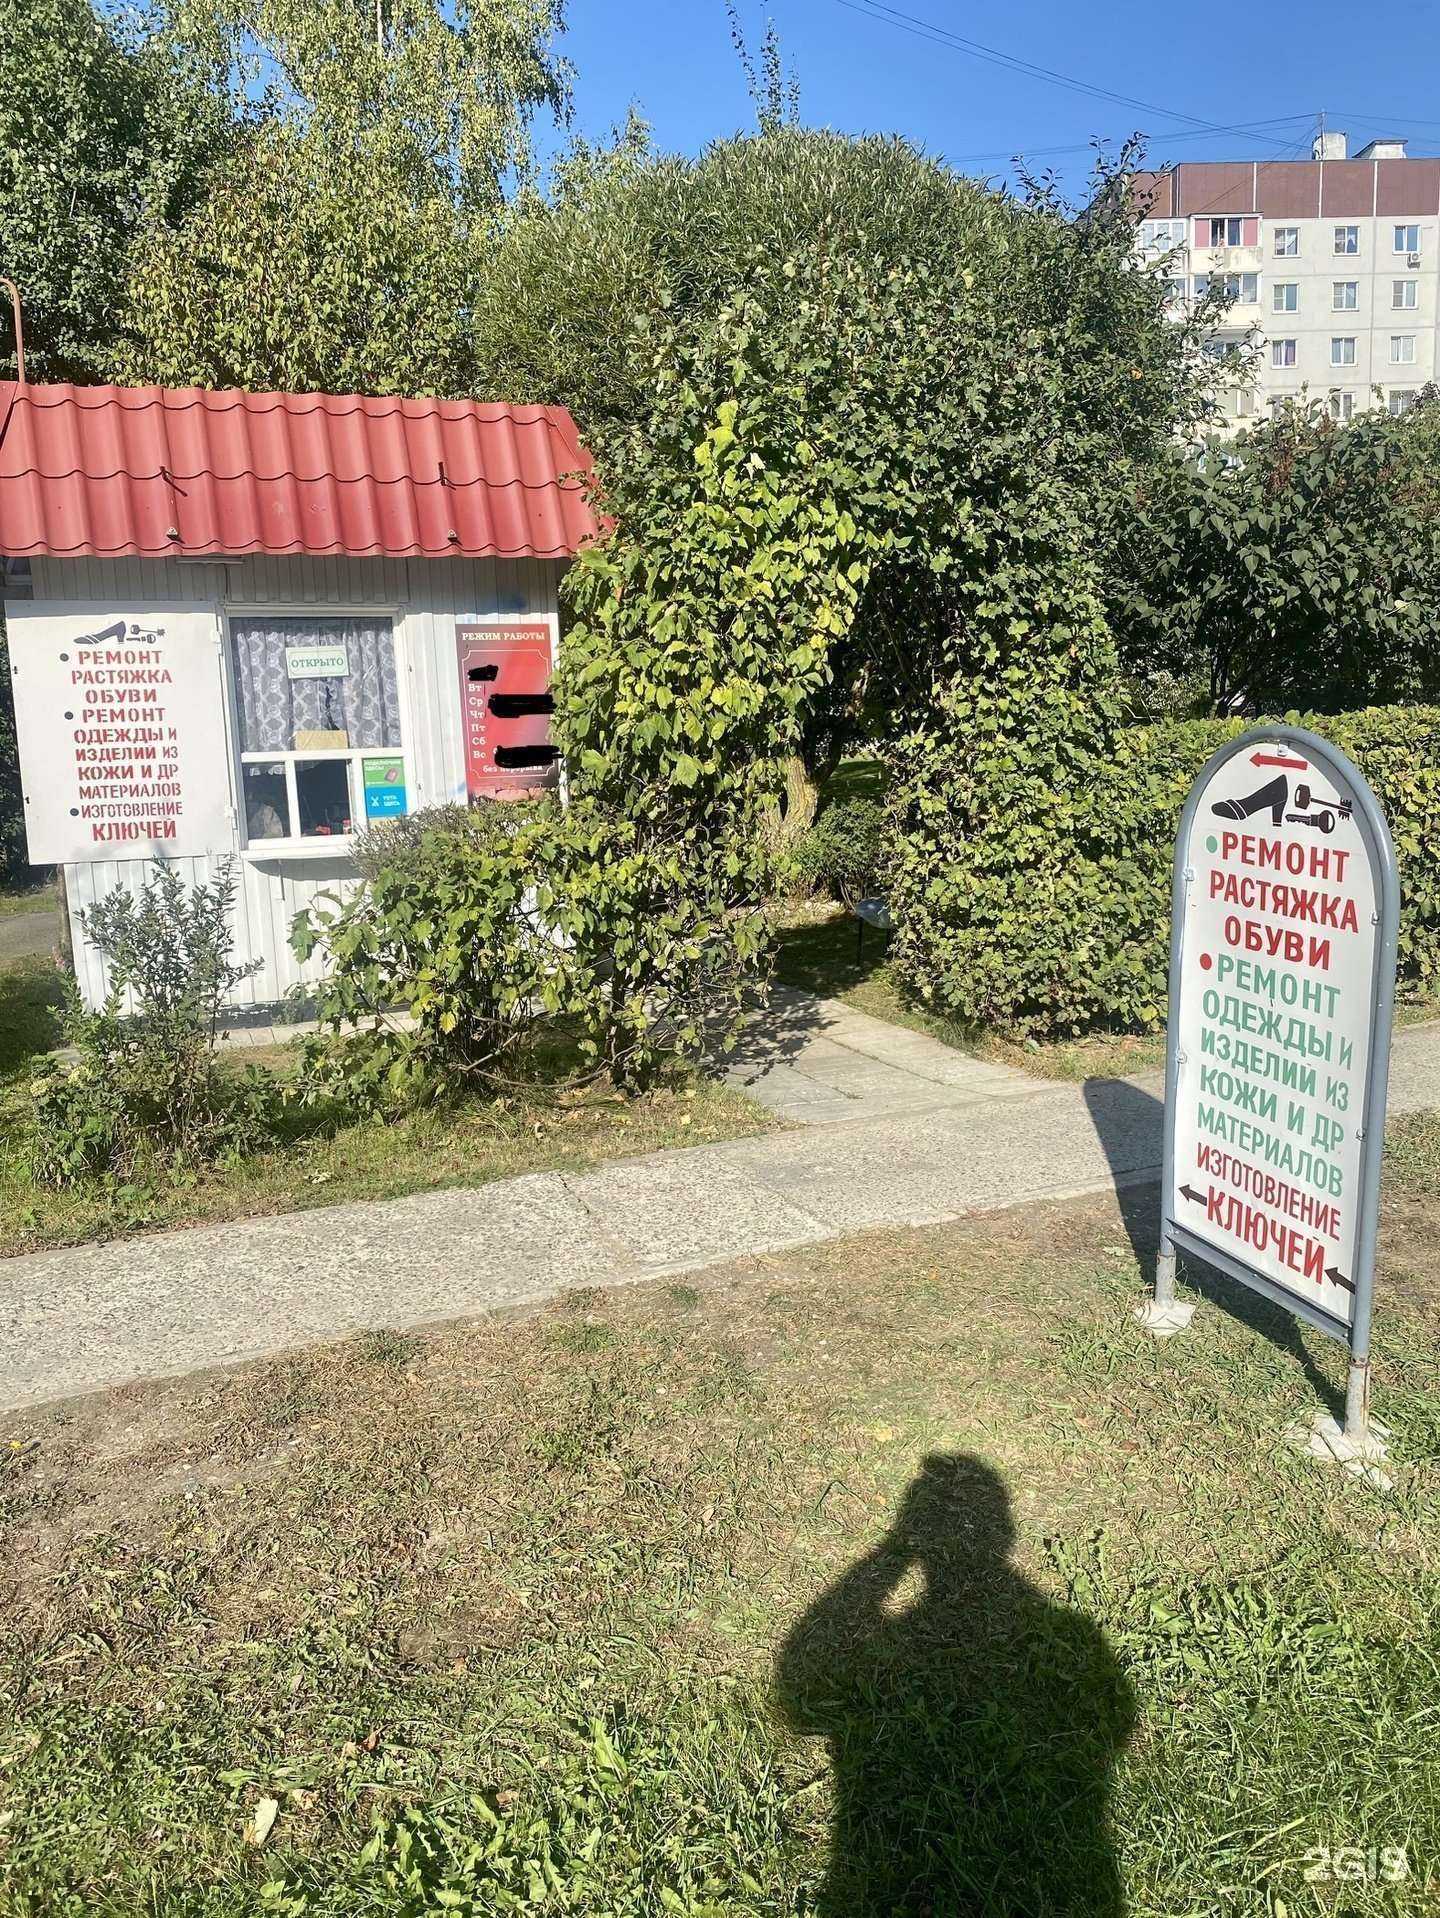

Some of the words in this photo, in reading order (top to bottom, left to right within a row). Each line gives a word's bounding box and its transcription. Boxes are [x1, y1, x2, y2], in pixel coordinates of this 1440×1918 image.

[462, 632, 501, 641] РЕЖИМ
[503, 632, 545, 640] РАБОТЫ
[78, 650, 163, 665] РЕМОНТ
[291, 657, 343, 668] ОТКРЫТО
[71, 669, 173, 685] РАСТЯЖКА
[85, 689, 157, 704] ОБУВИ
[468, 684, 481, 692] Вт
[469, 697, 483, 706] Ср
[82, 708, 166, 723] РЕМОНТ
[470, 710, 485, 719] Чт
[73, 729, 163, 744] ОДЕЖДЫ
[168, 727, 177, 741] И
[471, 724, 486, 732] Пт
[472, 736, 486, 745] Сб
[75, 744, 156, 762] ИЗДЕЛИЙ
[162, 746, 178, 758] ИЗ
[78, 765, 134, 780] КОЖИ
[141, 764, 152, 778] И
[157, 764, 179, 780] ДР
[79, 783, 181, 799] МАТЕРИАЛОВ
[81, 802, 183, 819] ИЗГОТОВЛЕНИЕ
[92, 819, 176, 841] КЛЮЧЕЙ
[1221, 831, 1350, 883] РЕМОНТ
[1209, 869, 1359, 934] РАСТЯЖКА
[1224, 915, 1331, 971] ОБУВИ
[1217, 953, 1341, 1018] РЕМОНТ
[1202, 989, 1332, 1061] ОДЕЖДЫ
[1339, 1037, 1353, 1070] И
[1200, 1027, 1316, 1097] ИЗДЕЛИЙ
[1326, 1076, 1348, 1112] ИЗ
[1200, 1064, 1277, 1123] КОЖИ
[1287, 1101, 1305, 1136] И
[1311, 1112, 1344, 1154] ДР
[1197, 1102, 1343, 1198] МАТЕРИАЛОВ
[1197, 1142, 1340, 1241] ИЗГОТОВЛЕНИЕ
[1207, 1185, 1325, 1284] КЛЮЧЕЙ
